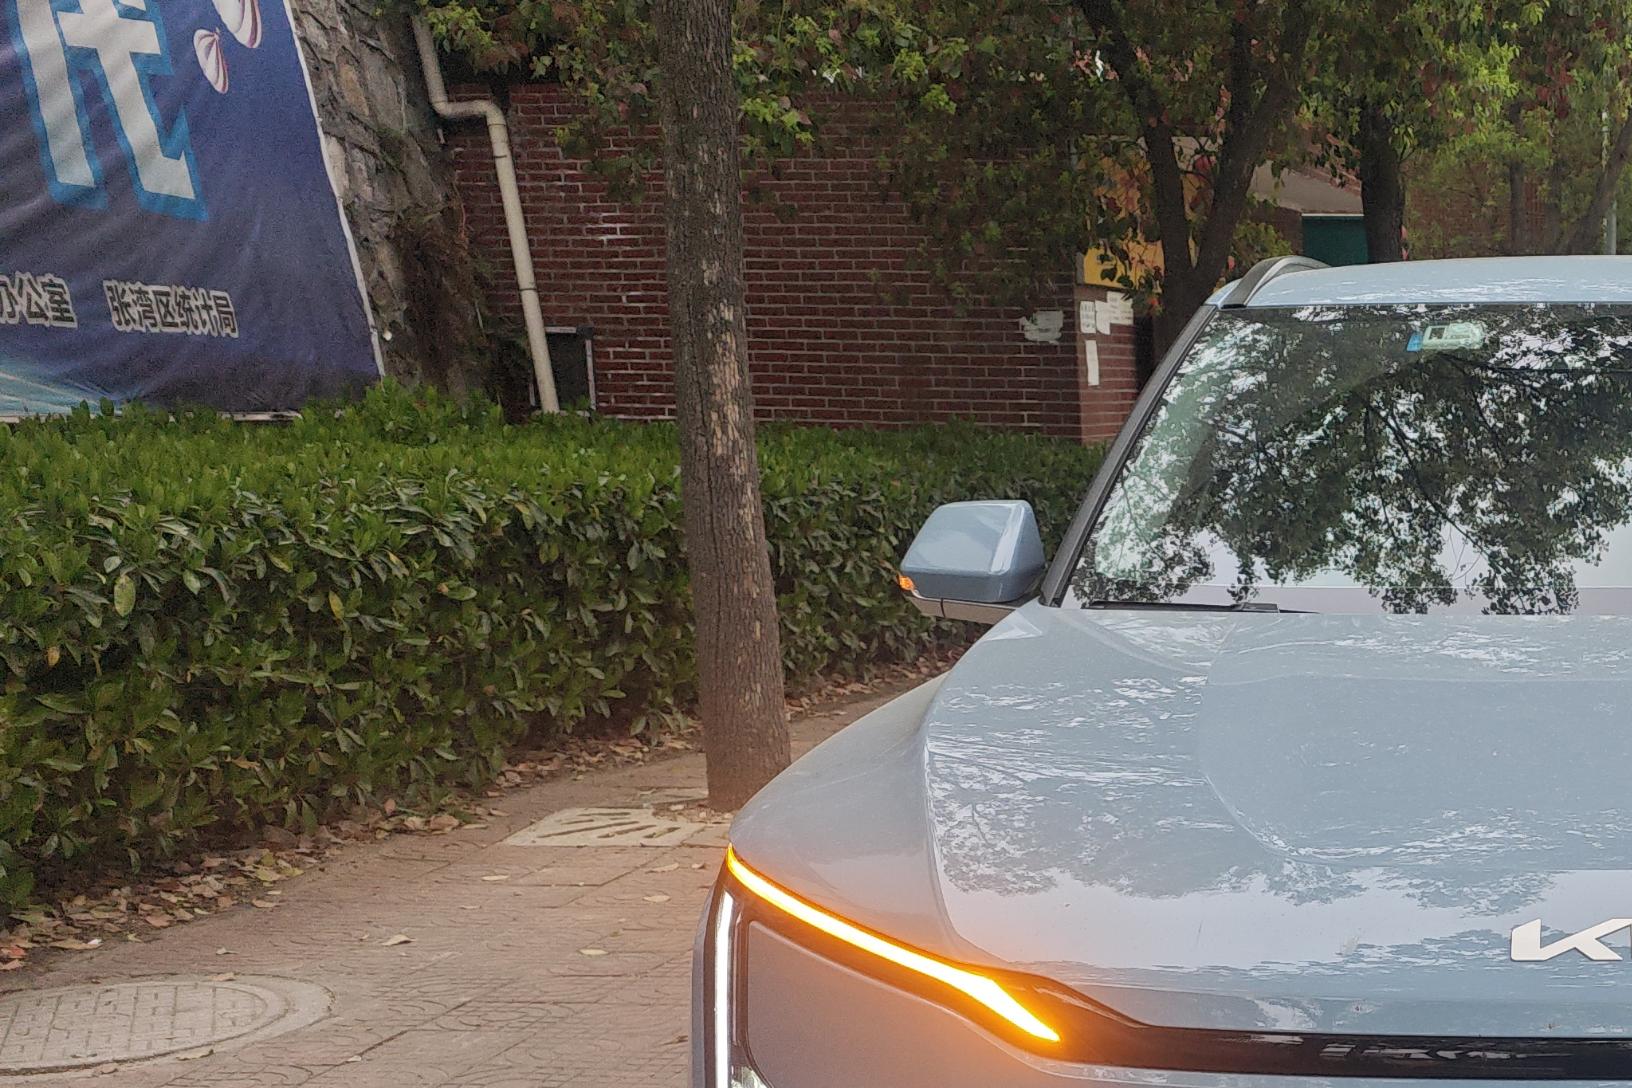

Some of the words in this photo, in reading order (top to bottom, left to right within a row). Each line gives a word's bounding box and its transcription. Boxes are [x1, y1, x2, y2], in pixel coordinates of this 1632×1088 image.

[104, 281, 238, 337] 张湾区统计局
